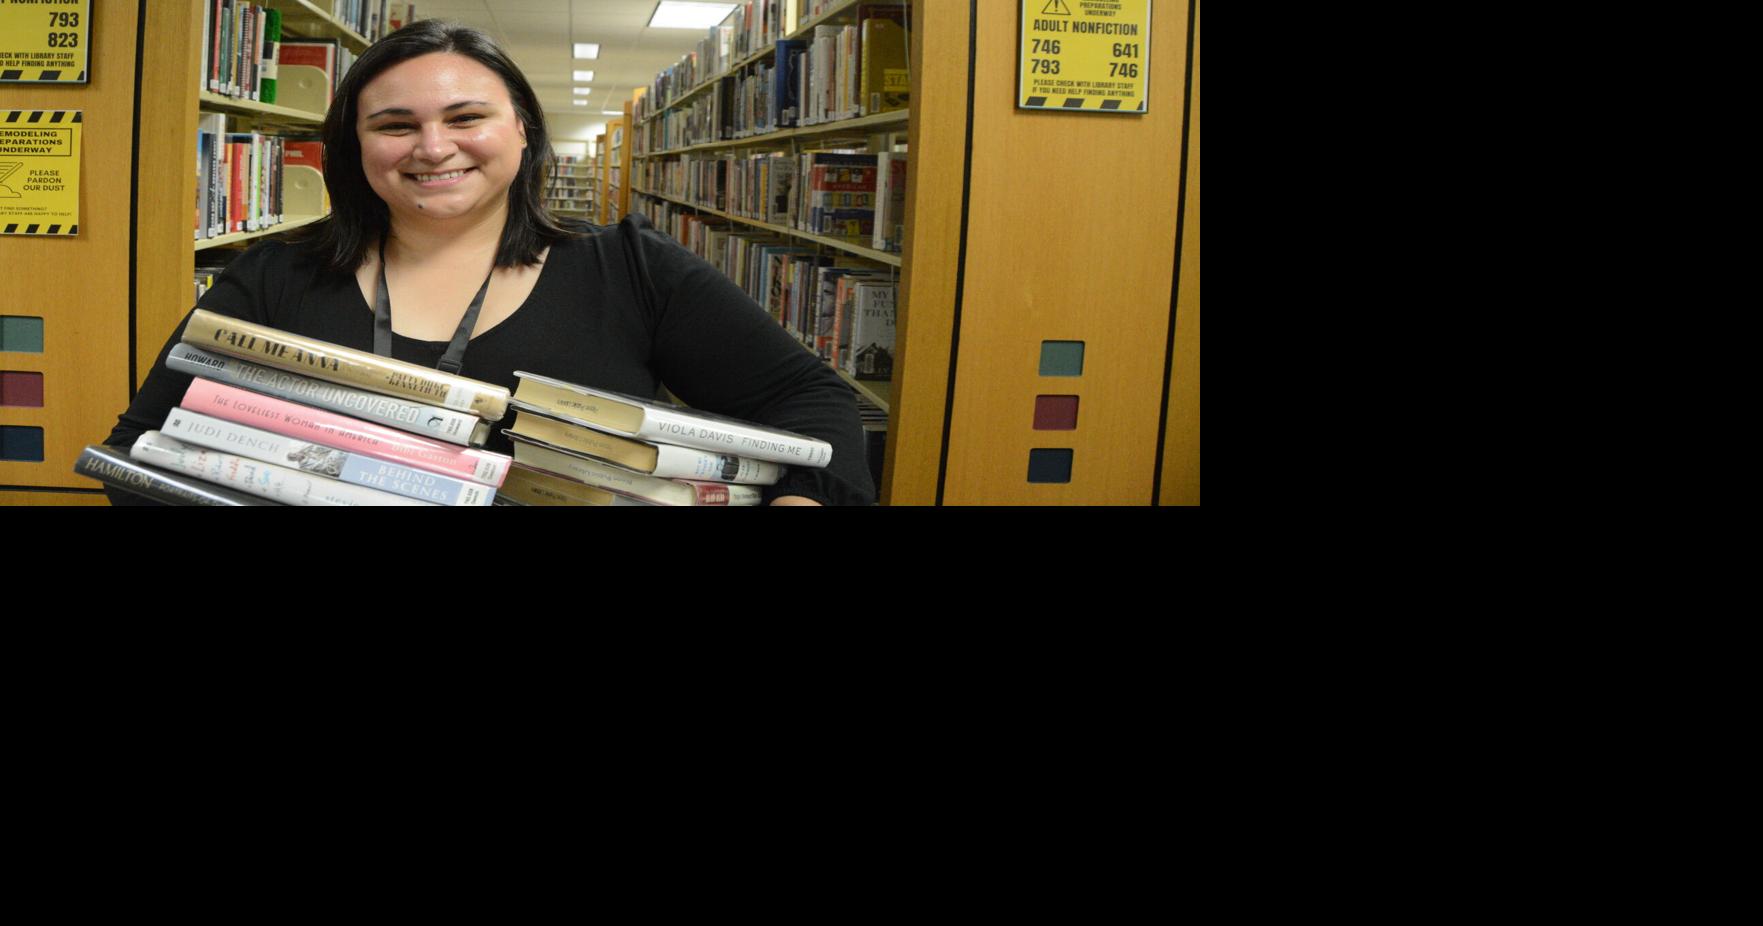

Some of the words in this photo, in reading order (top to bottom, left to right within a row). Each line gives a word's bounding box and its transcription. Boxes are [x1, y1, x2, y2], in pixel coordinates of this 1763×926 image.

[49, 12, 79, 27] 793
[1033, 19, 1068, 32] ADULT
[1072, 21, 1138, 36] NONFICTION
[48, 32, 78, 47] 823
[1032, 39, 1060, 54] 746
[1112, 43, 1139, 58] 641
[1031, 59, 1060, 75] 793
[1109, 62, 1138, 78] 746
[184, 351, 225, 370] HOWARD
[214, 328, 256, 351] CALL
[264, 339, 289, 359] ME
[292, 349, 339, 371] ANNA
[236, 364, 267, 385] THE
[267, 371, 320, 398] ACTOR
[322, 388, 420, 425] UNCOVERED
[213, 395, 228, 406] THE
[233, 400, 280, 420] LOVELIEST
[187, 422, 221, 438] JUDI
[226, 432, 280, 453] DENCH
[658, 422, 696, 437] VIOLA
[699, 428, 735, 444] DAVIS
[741, 437, 785, 453] FINDING
[787, 447, 802, 456] ME
[86, 457, 152, 488] HAMILTON
[377, 464, 436, 486] BEHIND
[359, 471, 385, 487] THE
[392, 478, 448, 500] SCENES
